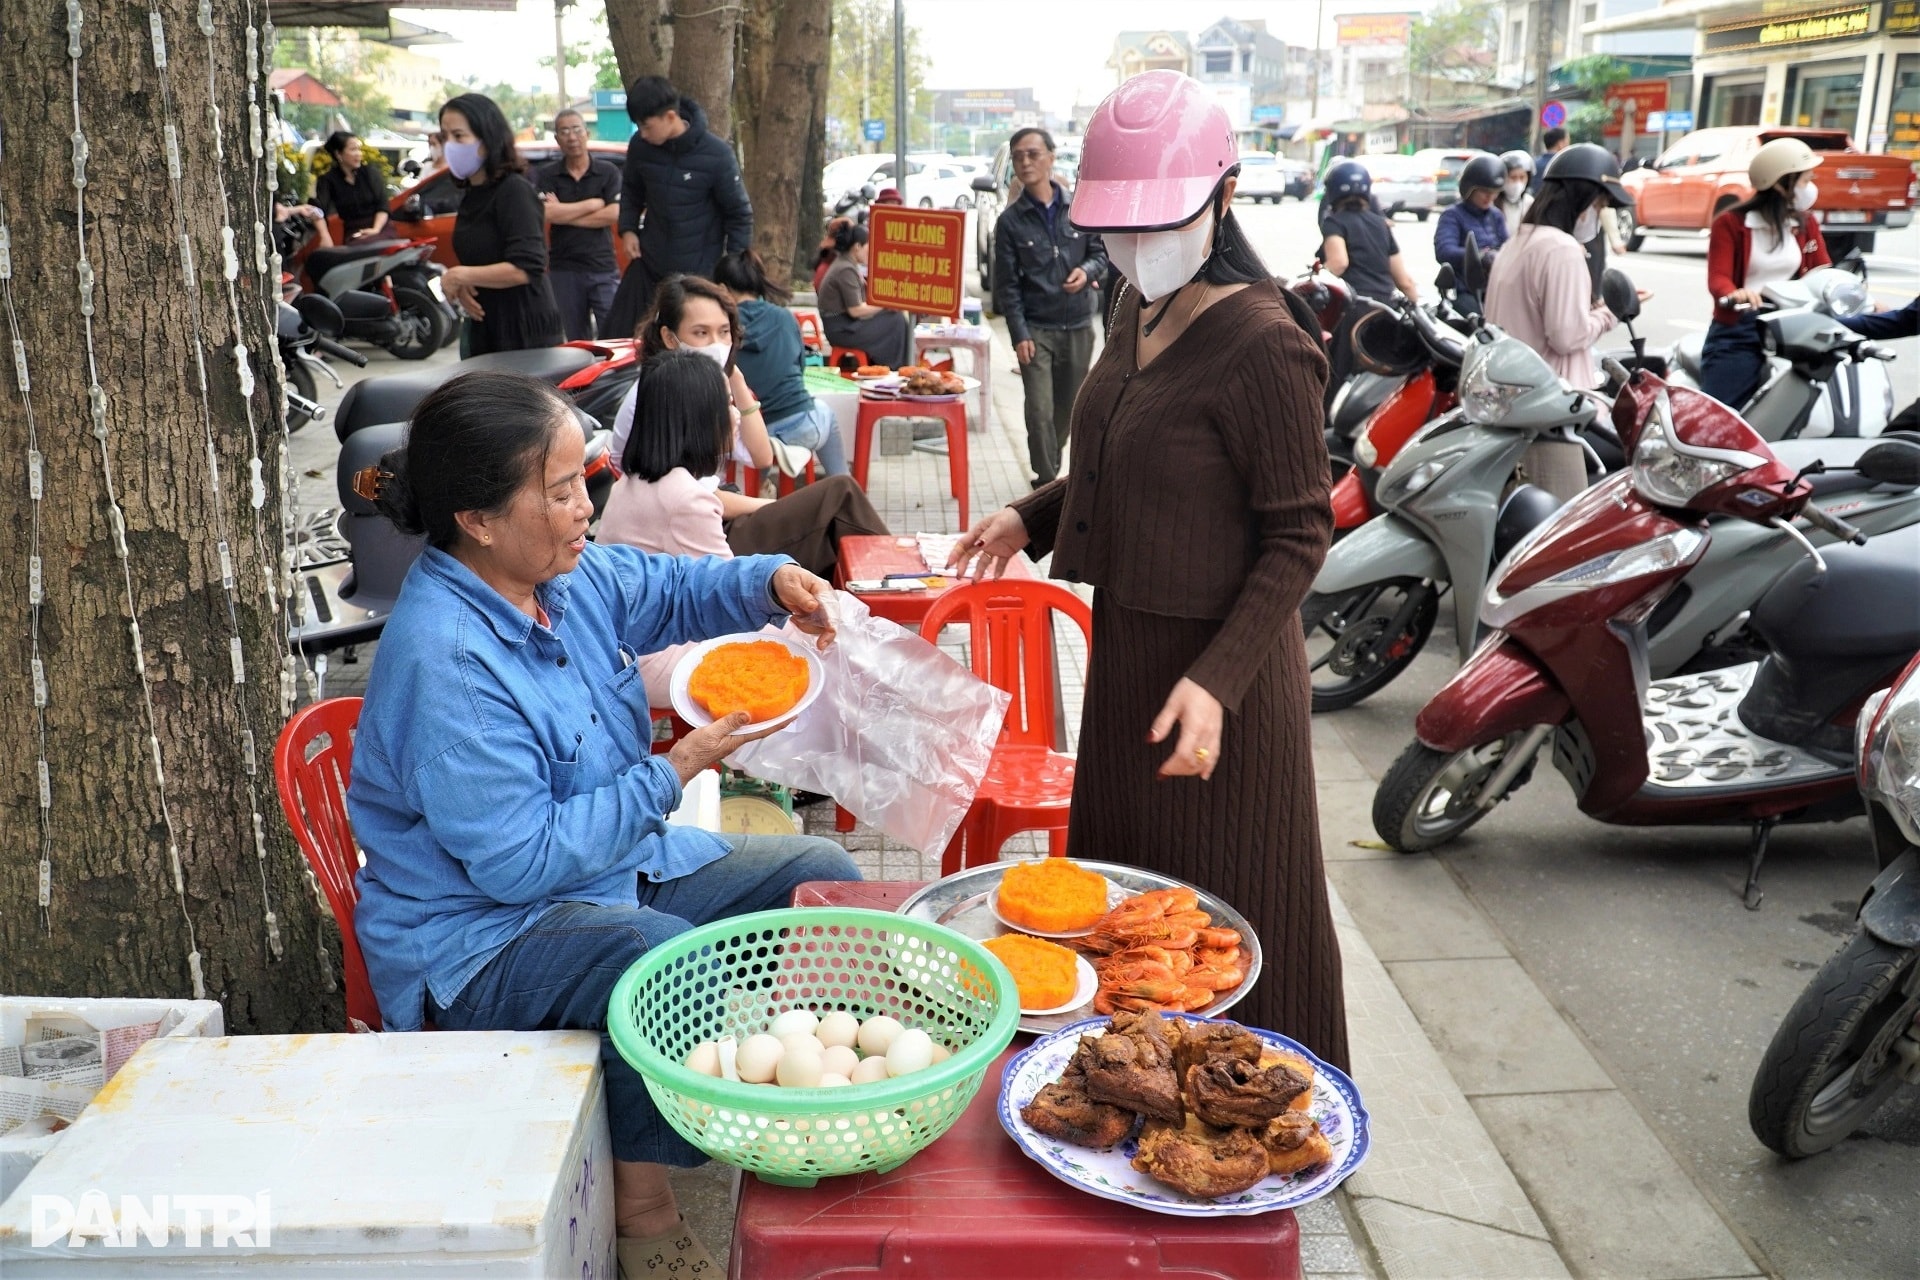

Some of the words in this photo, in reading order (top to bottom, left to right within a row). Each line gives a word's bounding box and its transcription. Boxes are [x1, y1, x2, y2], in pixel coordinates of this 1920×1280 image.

[884, 220, 907, 242] VUI
[909, 219, 946, 246] LÒNG
[877, 249, 912, 273] KHÔNG
[912, 252, 936, 278] ĐẬU
[936, 257, 952, 277] XE
[873, 275, 897, 298] TRƯỚC
[920, 283, 932, 302] CƠ
[932, 285, 954, 306] QUAN
